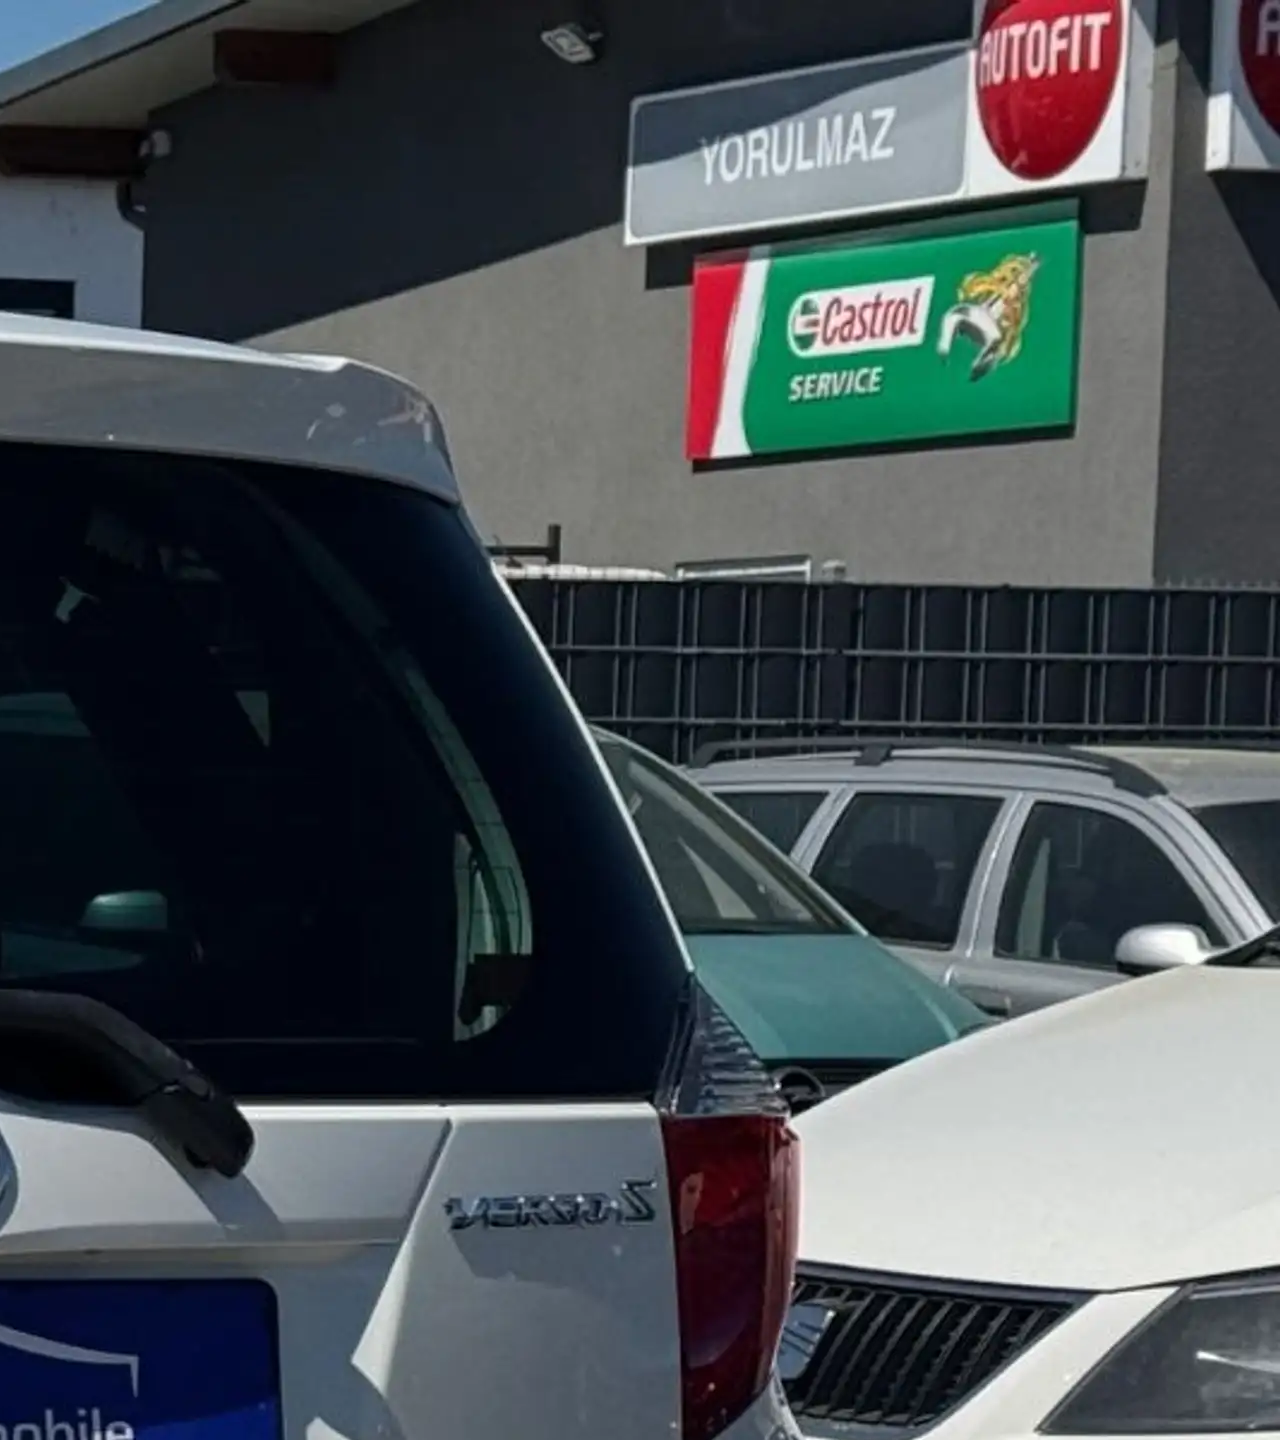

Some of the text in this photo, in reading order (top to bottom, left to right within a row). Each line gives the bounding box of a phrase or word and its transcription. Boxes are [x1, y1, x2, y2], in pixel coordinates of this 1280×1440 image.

[979, 11, 1112, 88] AUTOFIT
[698, 106, 898, 186] YORULMAZ
[821, 285, 923, 347] Castrol
[788, 366, 884, 402] SERVICE
